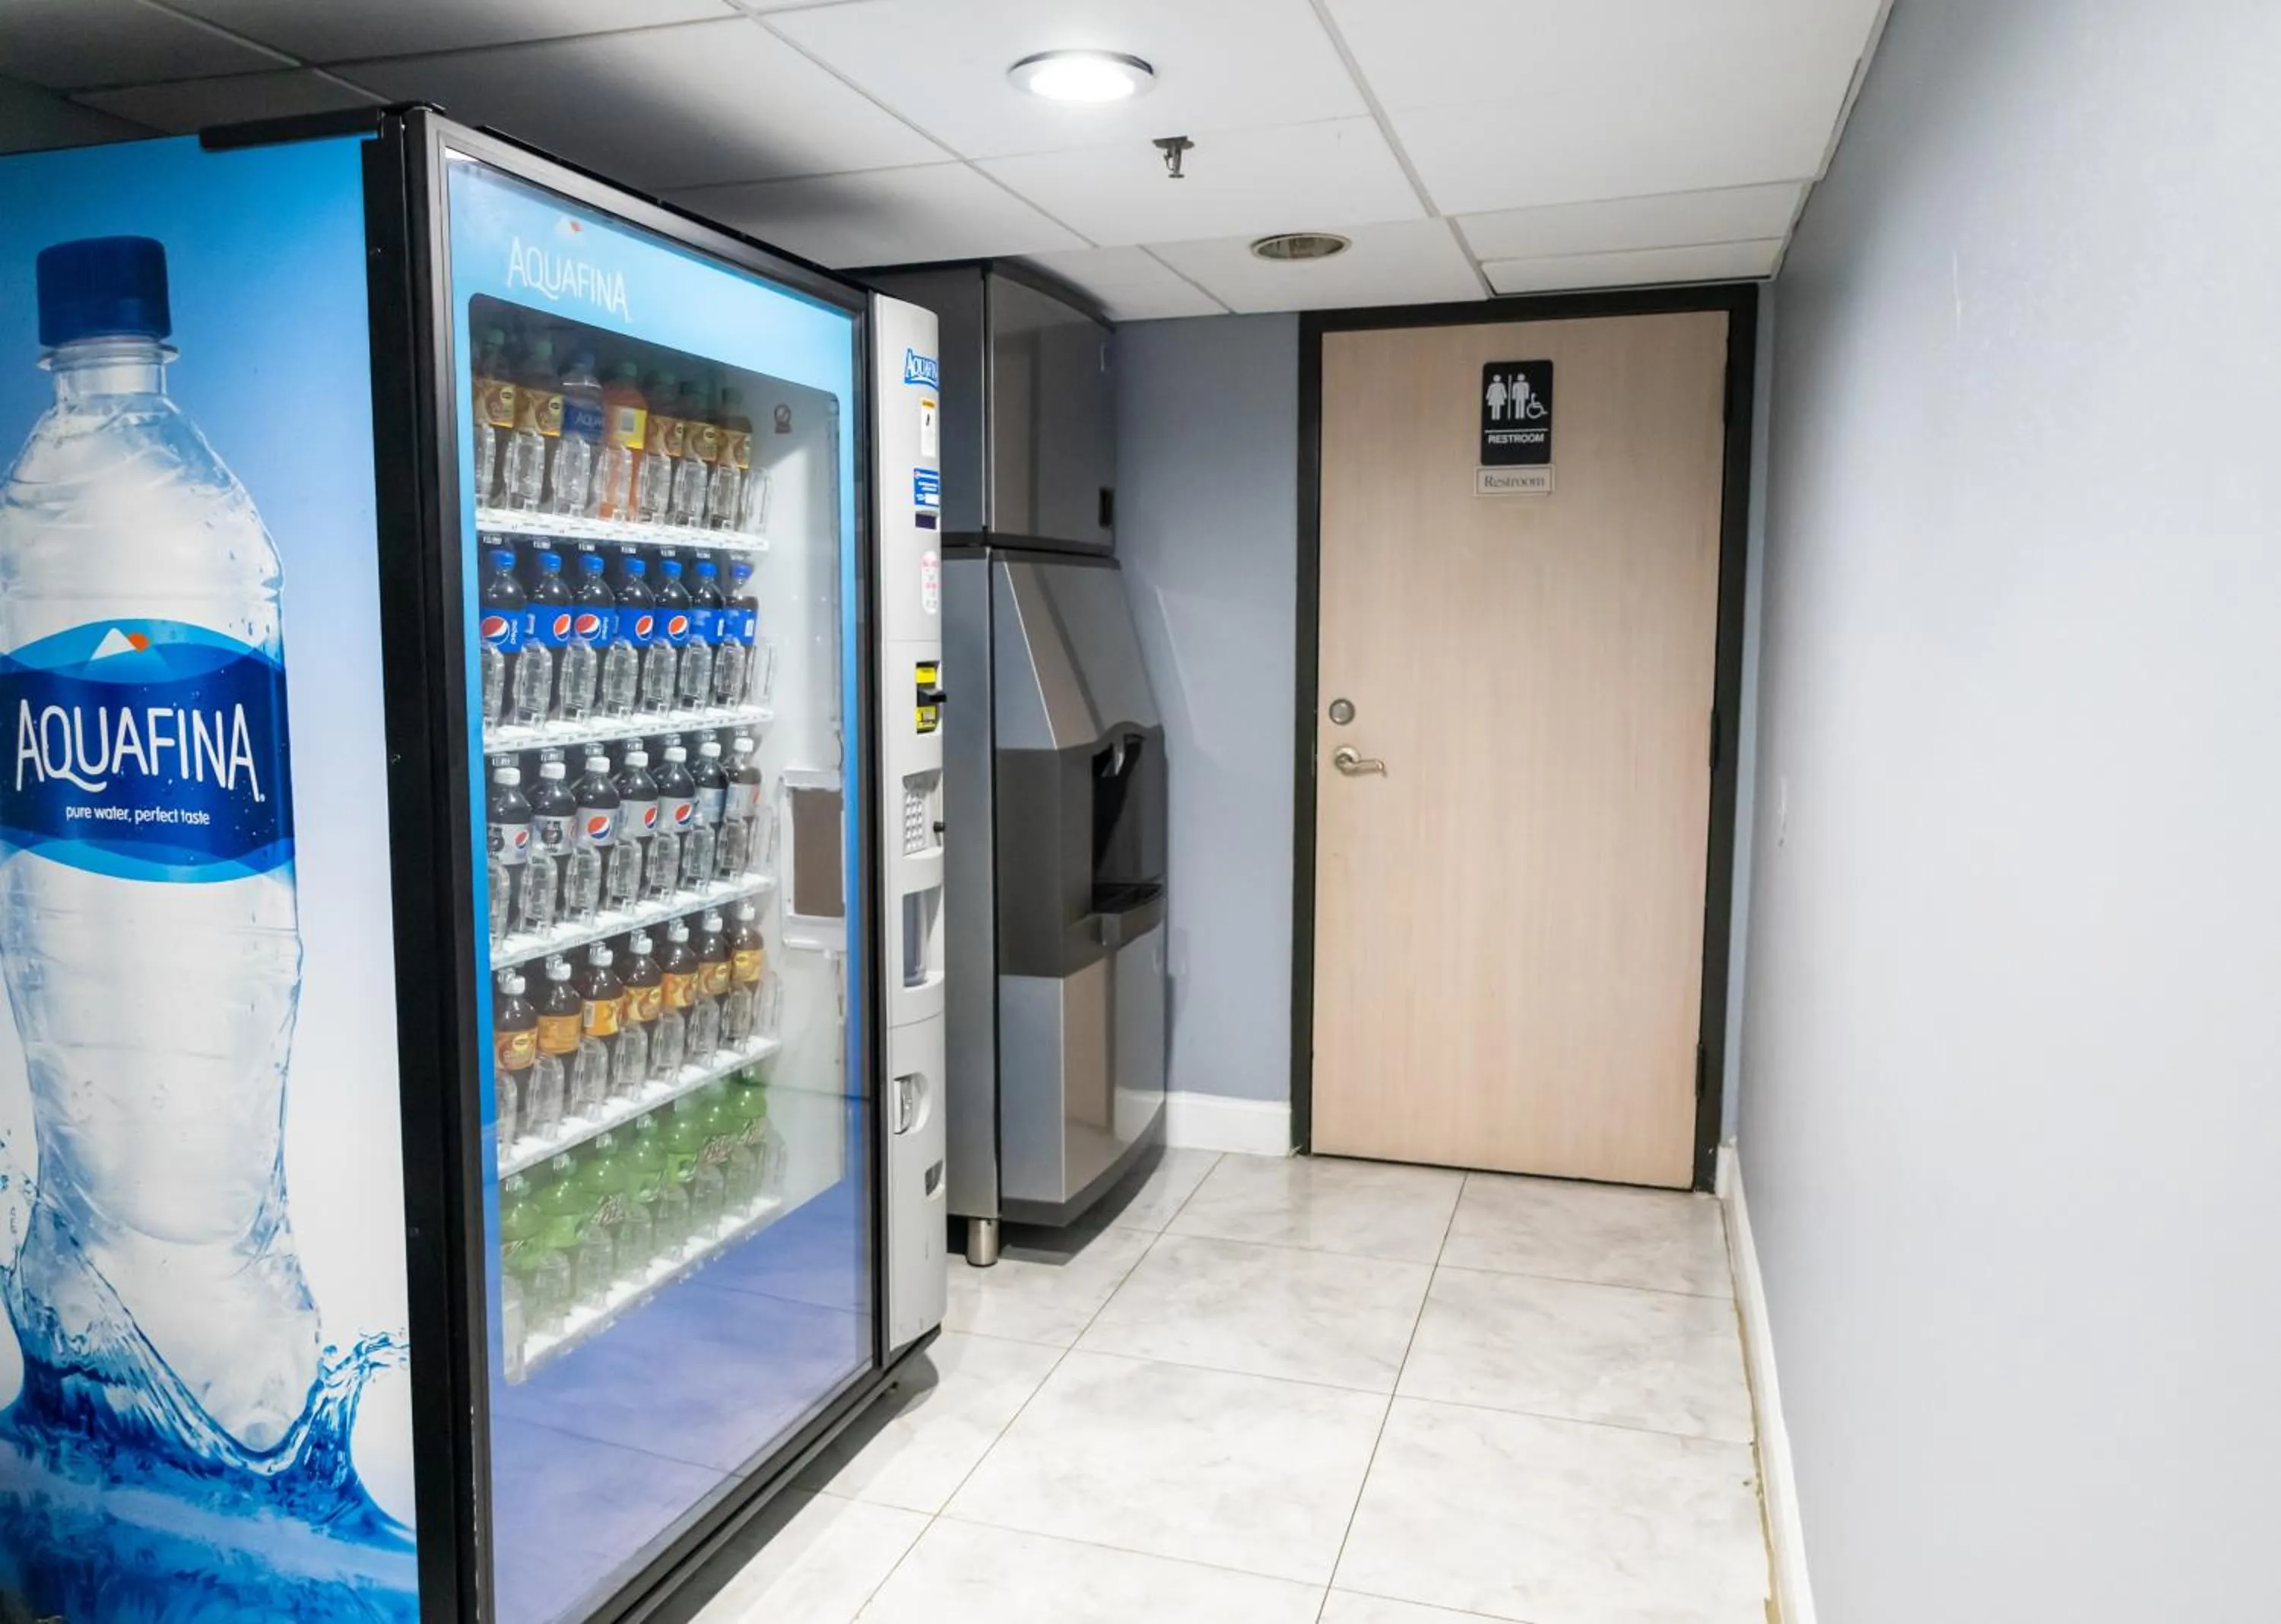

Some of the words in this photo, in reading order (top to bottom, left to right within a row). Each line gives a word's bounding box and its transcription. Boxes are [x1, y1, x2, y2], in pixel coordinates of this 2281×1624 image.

[506, 236, 630, 323] AQUAFINA
[1488, 433, 1544, 443] RESTROOM
[1484, 475, 1545, 487] Restroom
[16, 699, 265, 803] AQUAFINA
[65, 806, 92, 822] pure
[94, 806, 132, 823] water,
[135, 806, 179, 825] perfect
[180, 809, 211, 826] taste
